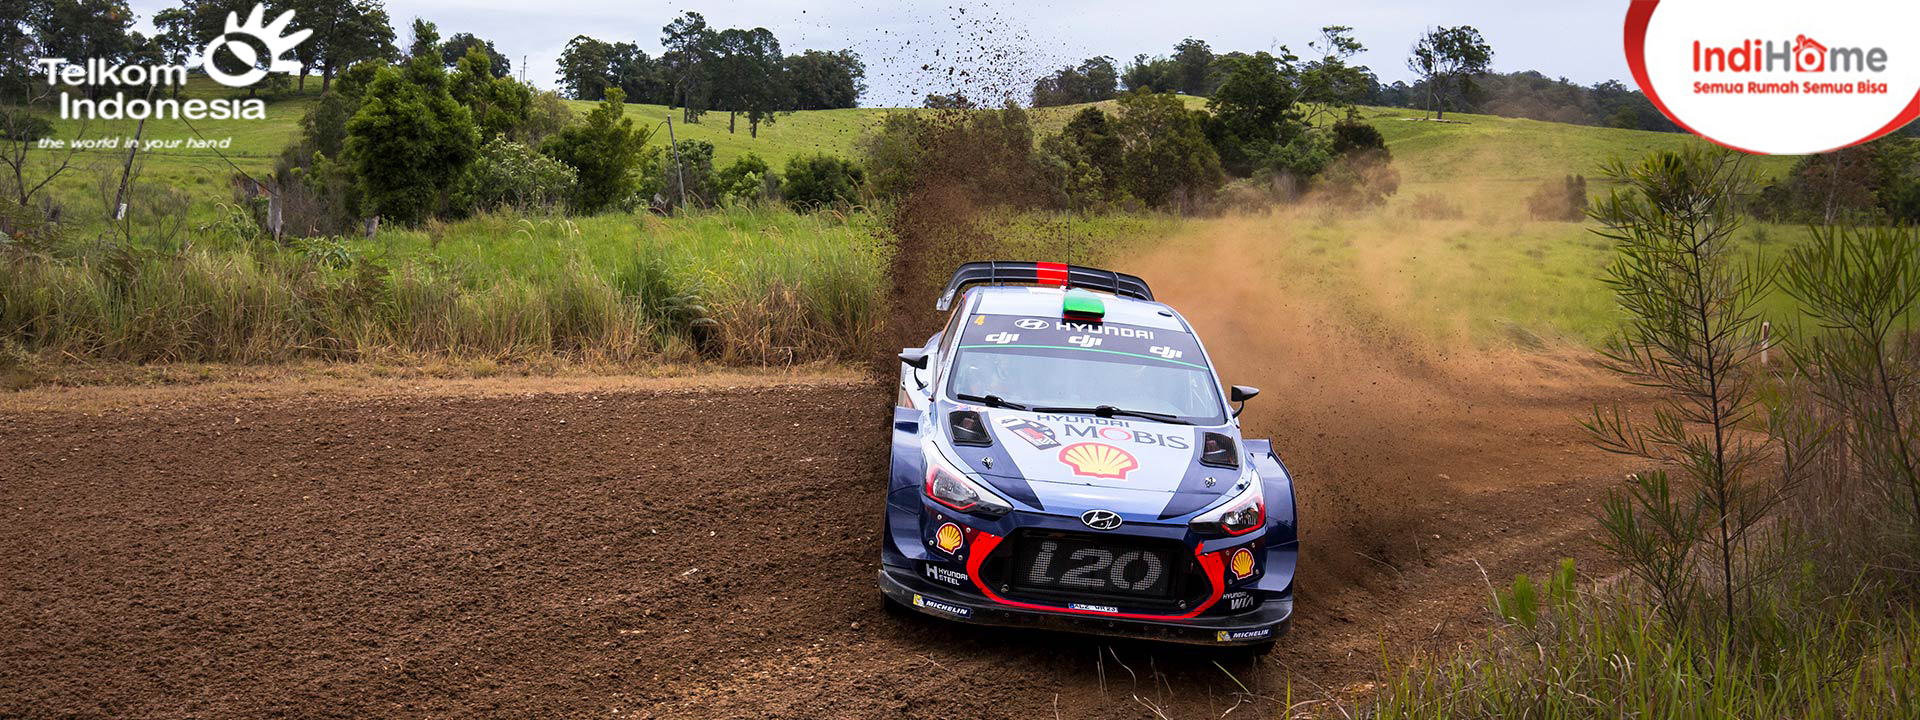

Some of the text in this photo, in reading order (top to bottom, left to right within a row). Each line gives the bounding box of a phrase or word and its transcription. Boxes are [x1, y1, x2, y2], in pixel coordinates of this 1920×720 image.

[974, 315, 986, 326] 4
[1056, 321, 1154, 340] HYUNDAI
[1036, 414, 1130, 428] HYUNDAI
[1064, 423, 1190, 450] MOBIS
[938, 567, 968, 581] HYUNDAI
[938, 574, 960, 586] STEEL
[925, 600, 968, 615] MICHELIN
[1232, 628, 1270, 638] MICHELIN
